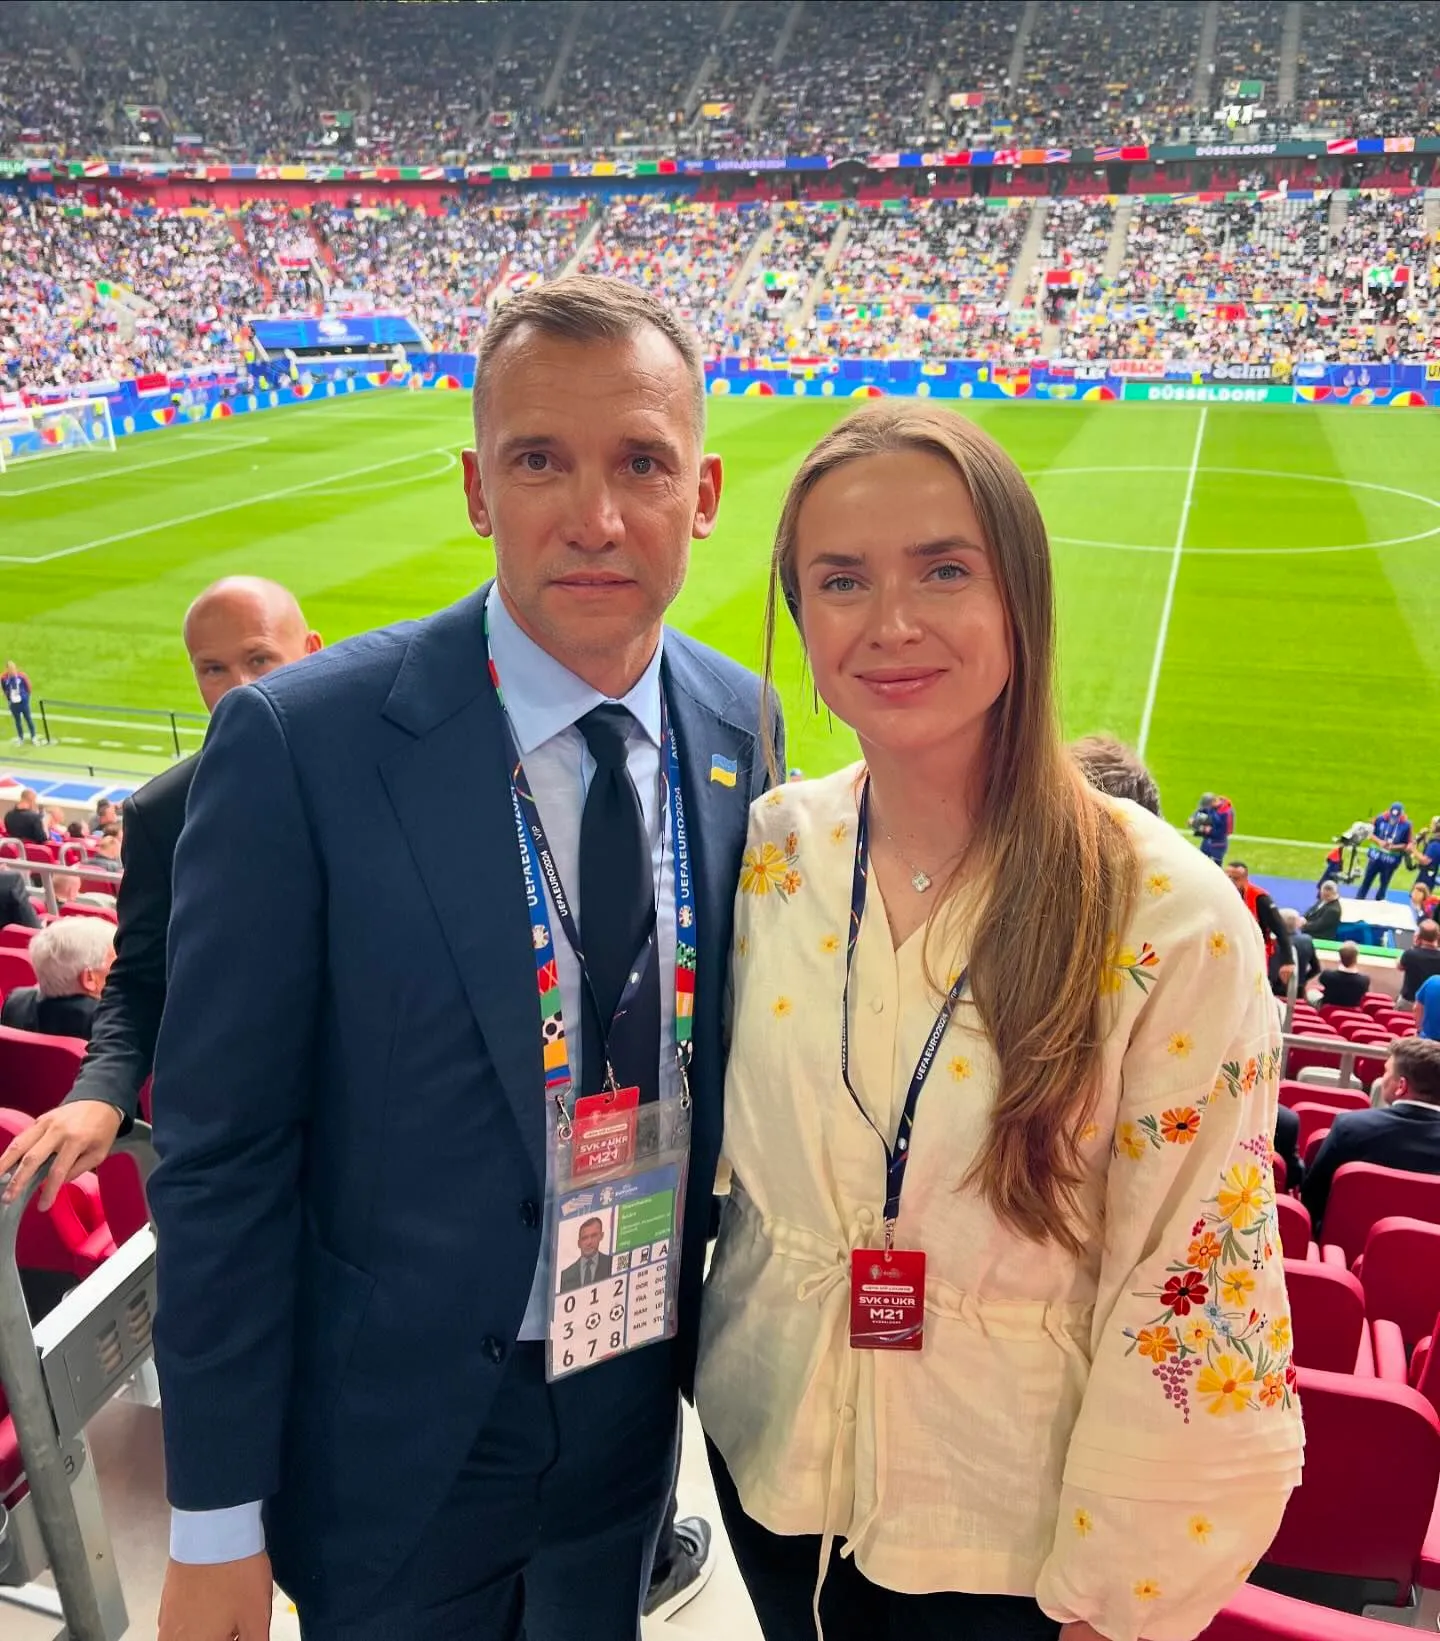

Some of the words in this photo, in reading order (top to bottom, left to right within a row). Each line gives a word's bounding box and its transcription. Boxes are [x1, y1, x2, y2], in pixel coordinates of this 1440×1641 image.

[1148, 385, 1268, 401] DÜSSELDORF
[531, 825, 543, 841] VIP
[674, 787, 690, 899] UEFAEURO2024
[540, 850, 568, 917] UEFAEURO2024
[916, 1012, 949, 1080] UEFAEURO2024
[580, 1141, 600, 1153] SVK
[659, 1243, 669, 1257] A
[590, 1287, 599, 1305] 1
[613, 1279, 624, 1297] 2
[859, 1296, 882, 1305] SVK
[891, 1298, 916, 1306] UKR
[869, 1307, 904, 1320] M21
[563, 1321, 574, 1340] 3
[563, 1348, 575, 1367] 6
[587, 1338, 598, 1357] 7
[610, 1330, 621, 1348] 8
